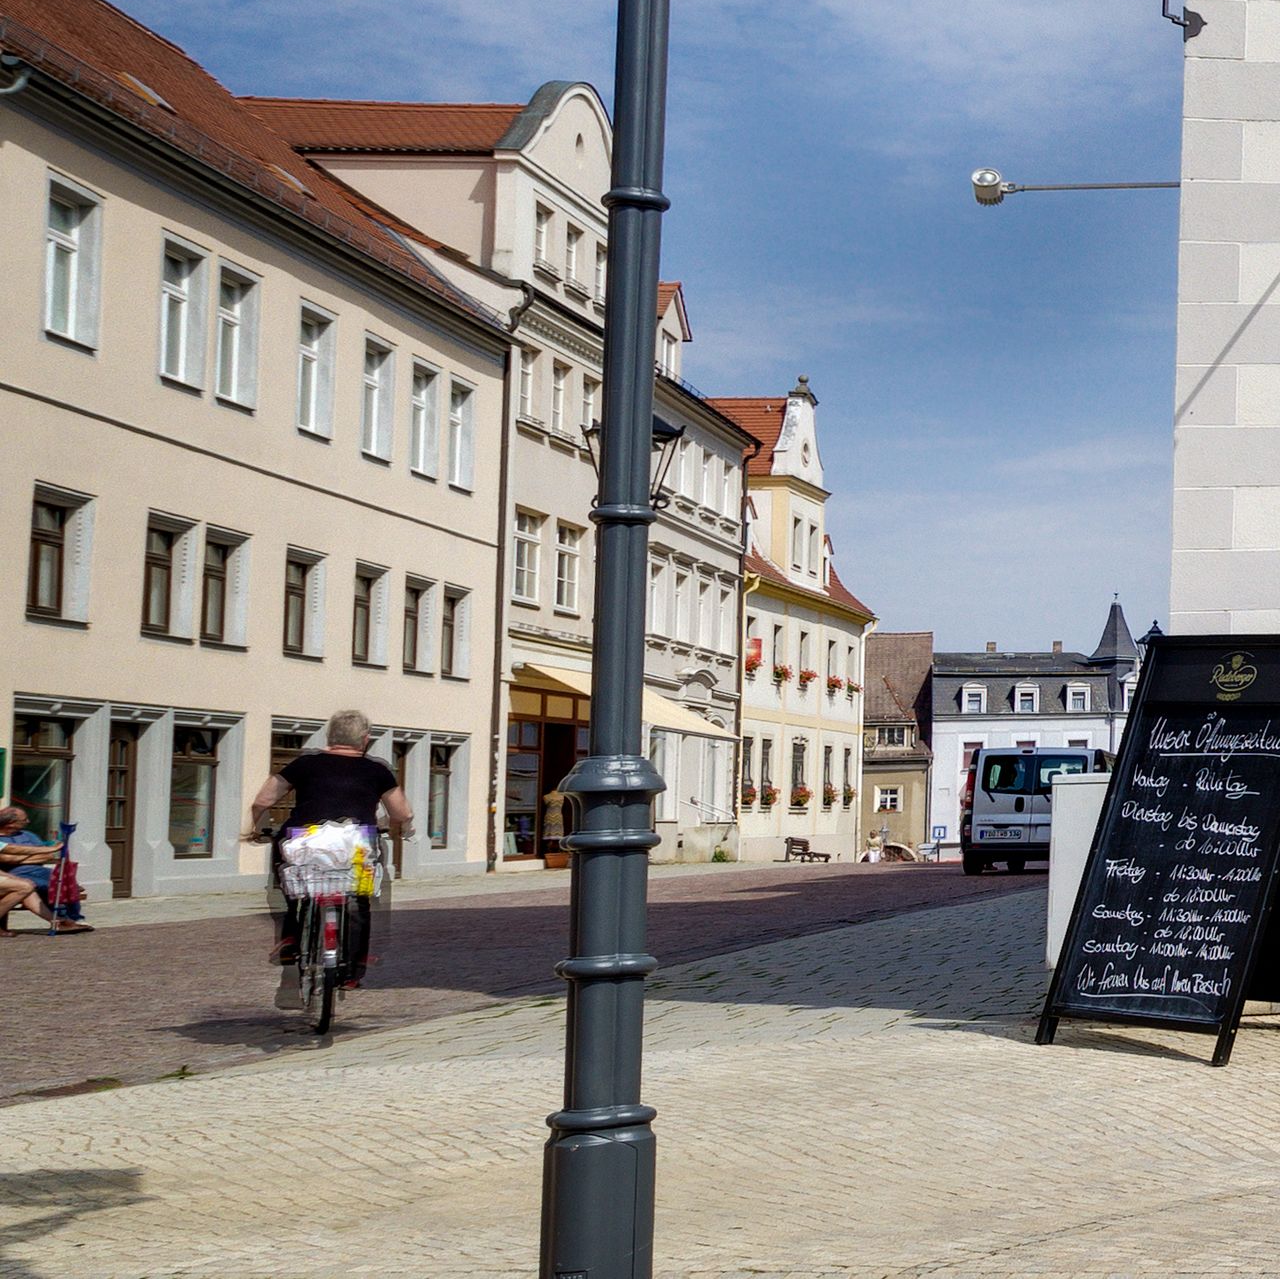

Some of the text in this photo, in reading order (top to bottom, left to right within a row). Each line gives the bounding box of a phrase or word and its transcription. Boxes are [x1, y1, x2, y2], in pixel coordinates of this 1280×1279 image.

[1132, 763, 1170, 798] Montag
[1121, 800, 1173, 832] Dienstag
[1177, 806, 1198, 831] bis
[1175, 832, 1196, 850] ab
[1105, 858, 1146, 884] Freitag
[1163, 887, 1181, 902] ab
[1092, 903, 1144, 927] Samstag
[1154, 925, 1174, 939] ab
[1082, 935, 1140, 961] Sonntag
[1077, 963, 1098, 991] Wir
[1151, 965, 1172, 995] auf
[1192, 967, 1233, 999] Besuch
